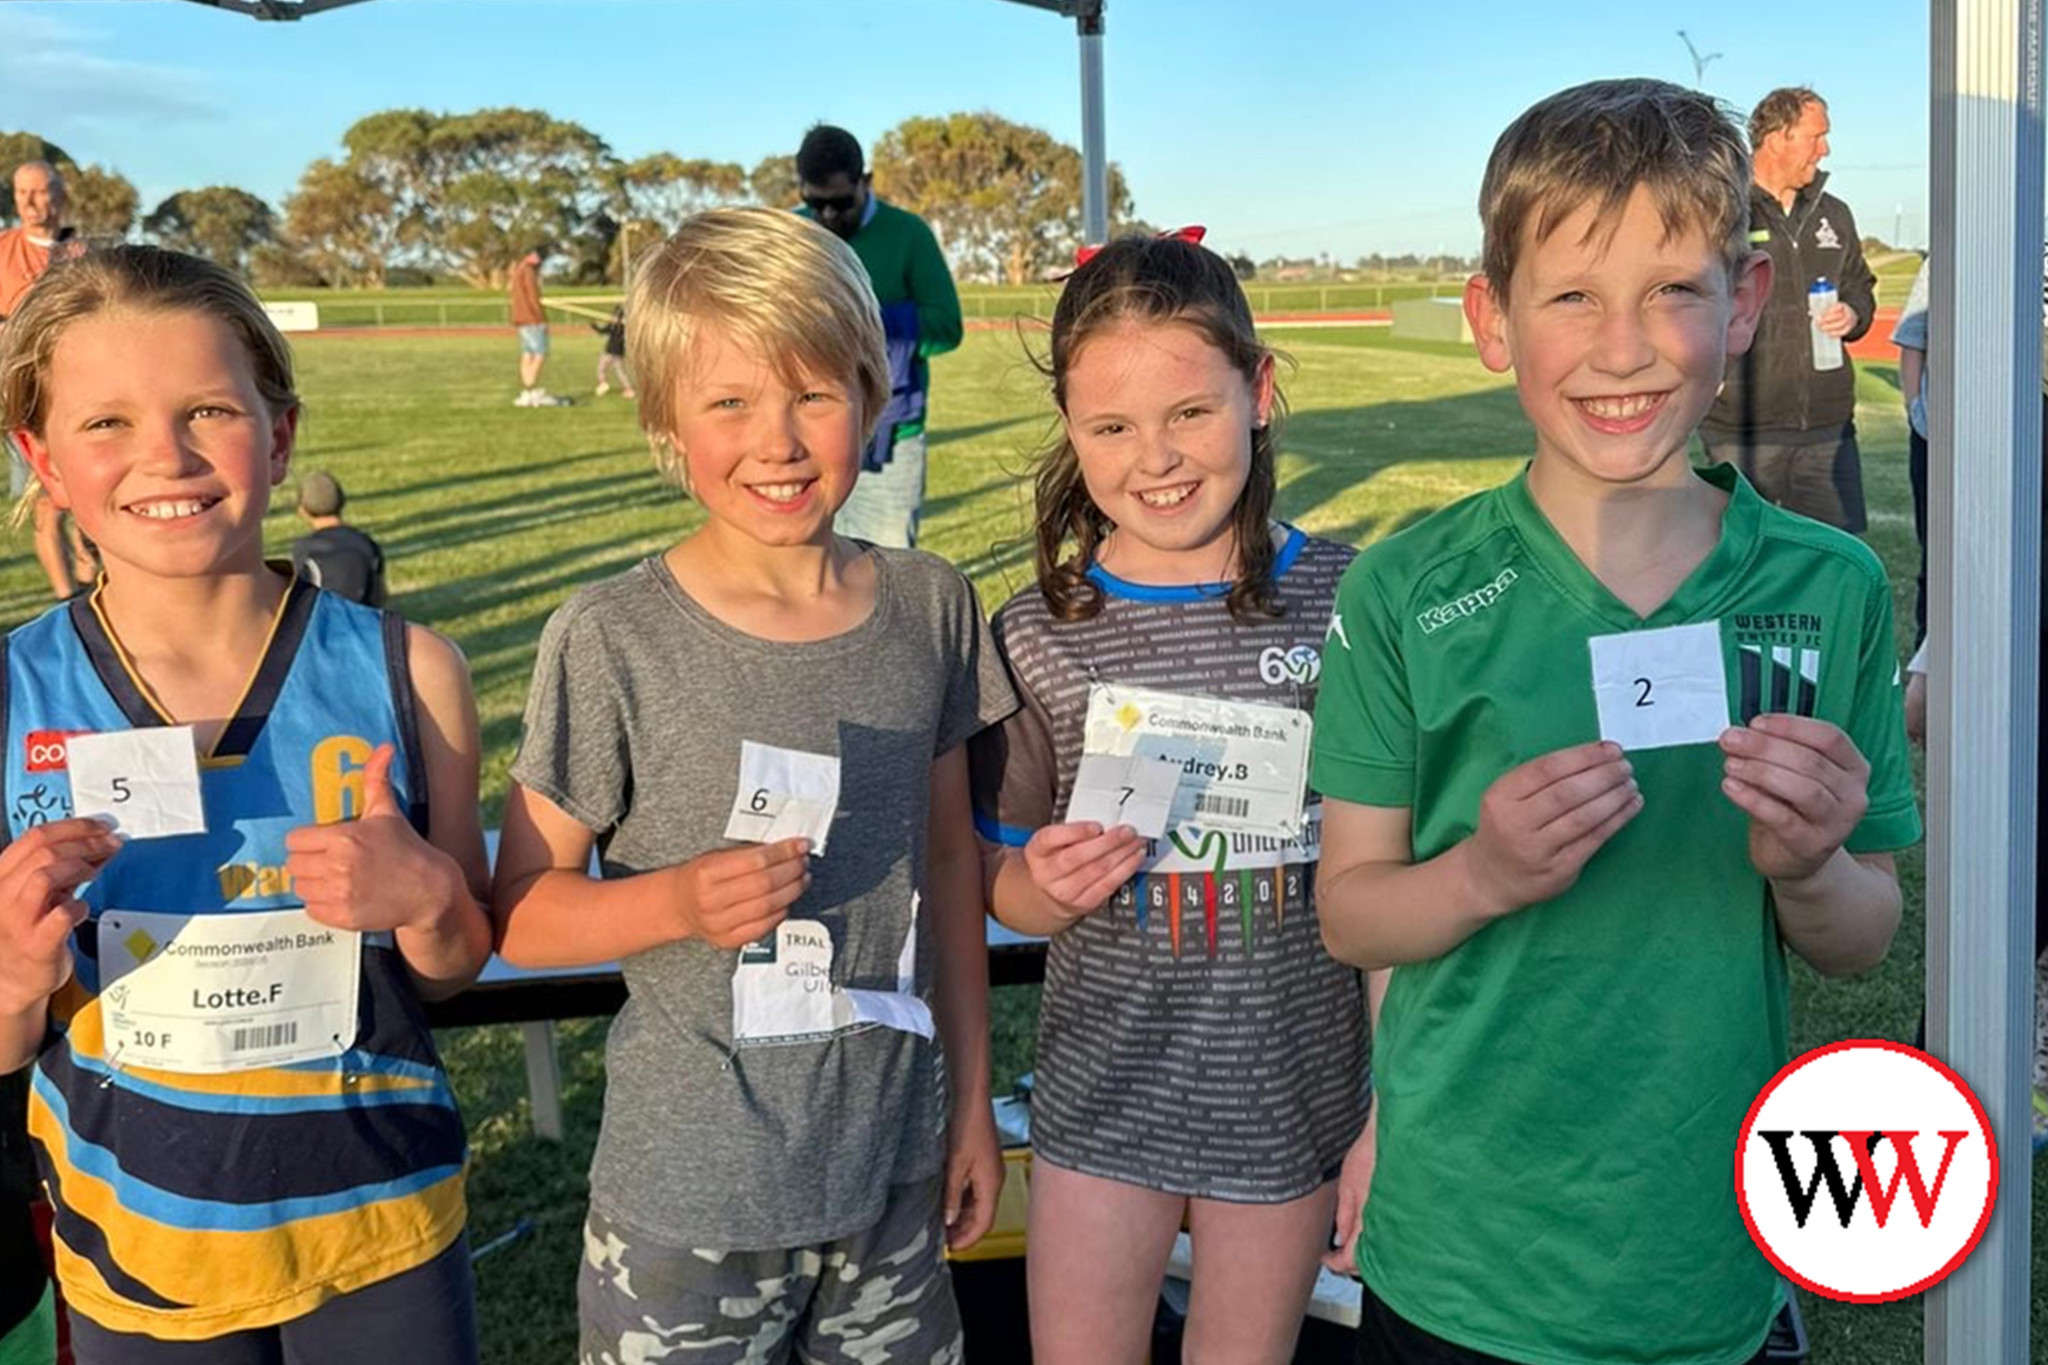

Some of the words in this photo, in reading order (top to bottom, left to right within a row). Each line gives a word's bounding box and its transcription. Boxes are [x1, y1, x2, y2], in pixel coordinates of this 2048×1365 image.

[1416, 567, 1519, 635] Kappa
[1734, 612, 1821, 632] WESTERN
[1634, 678, 1655, 707] 2
[1149, 713, 1252, 738] Commonwealth
[1253, 726, 1288, 742] Bank
[111, 777, 131, 803] 5
[751, 788, 768, 812] 6
[1119, 787, 1134, 806] 7
[165, 935, 294, 956] Commonwealth
[296, 931, 334, 949] Bank
[785, 933, 826, 949] TRIAL
[192, 983, 283, 1010] Lotte.F
[134, 1030, 156, 1048] 10
[161, 1034, 172, 1049] F
